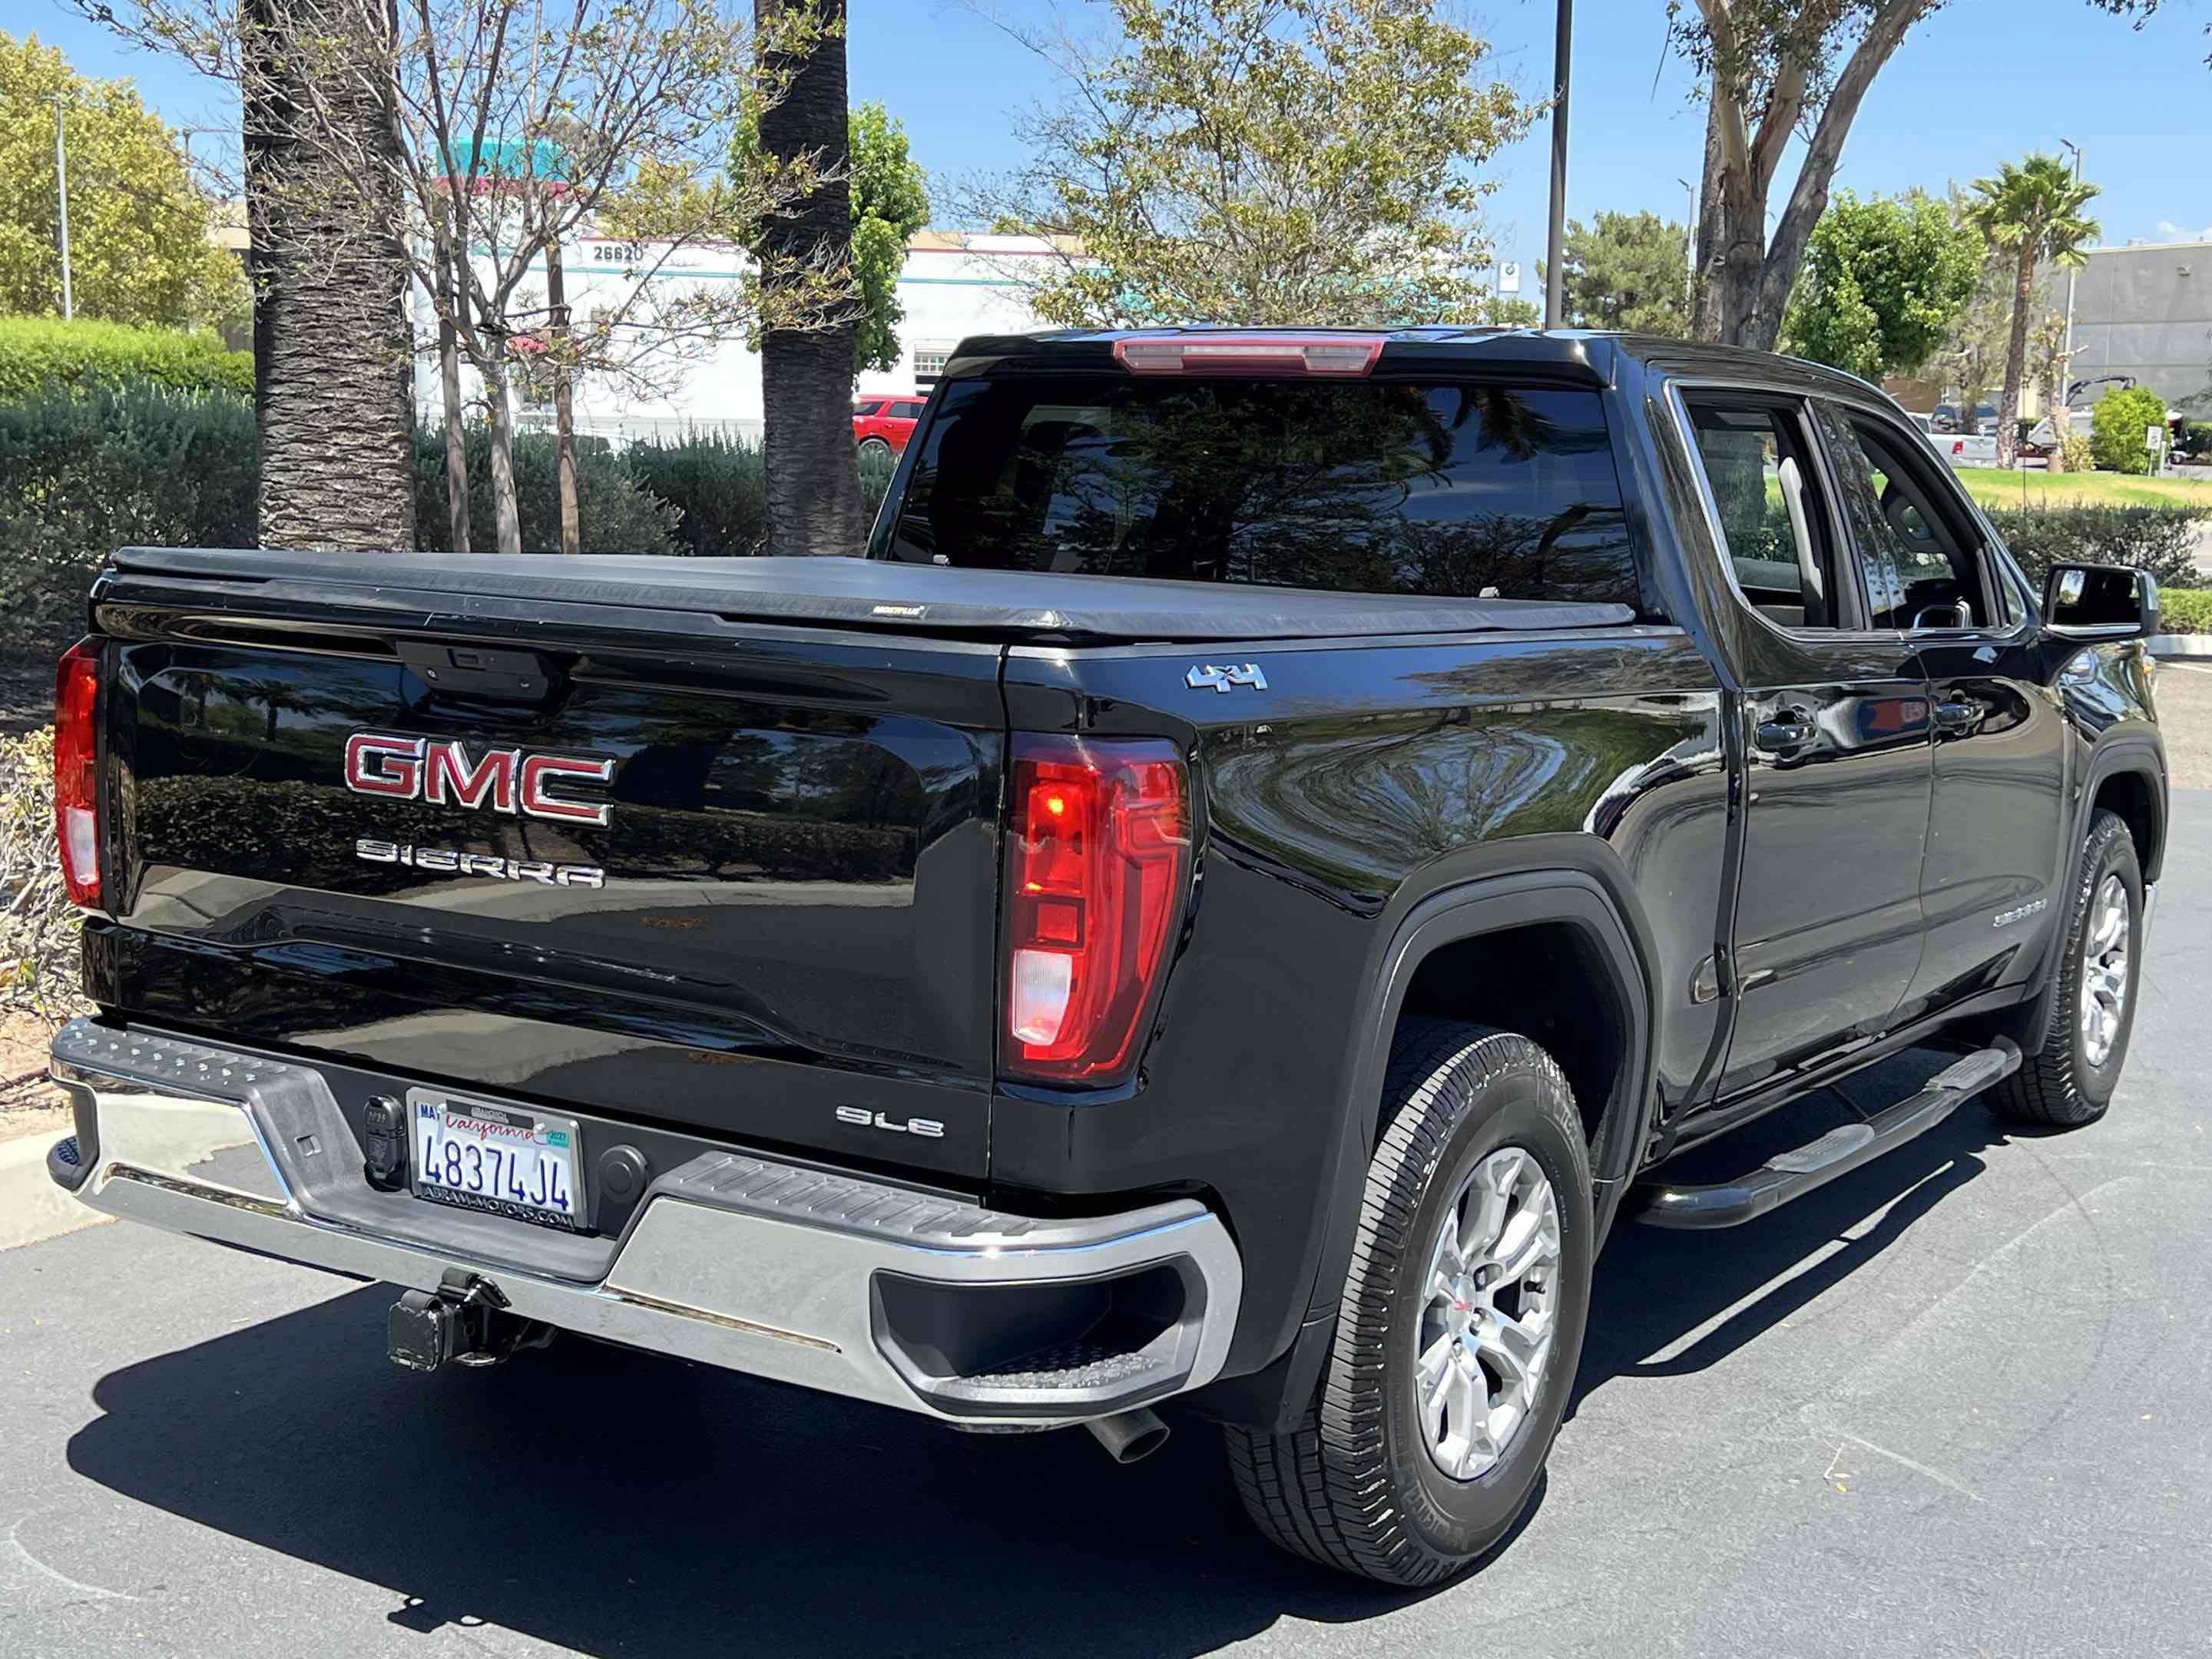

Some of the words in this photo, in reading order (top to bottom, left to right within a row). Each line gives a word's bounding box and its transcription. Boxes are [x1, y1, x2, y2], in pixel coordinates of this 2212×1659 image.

[345, 733, 614, 826] GMC
[356, 839, 606, 889] SIERRA
[836, 1105, 945, 1137] SLE
[425, 1134, 569, 1211] 48374J4
